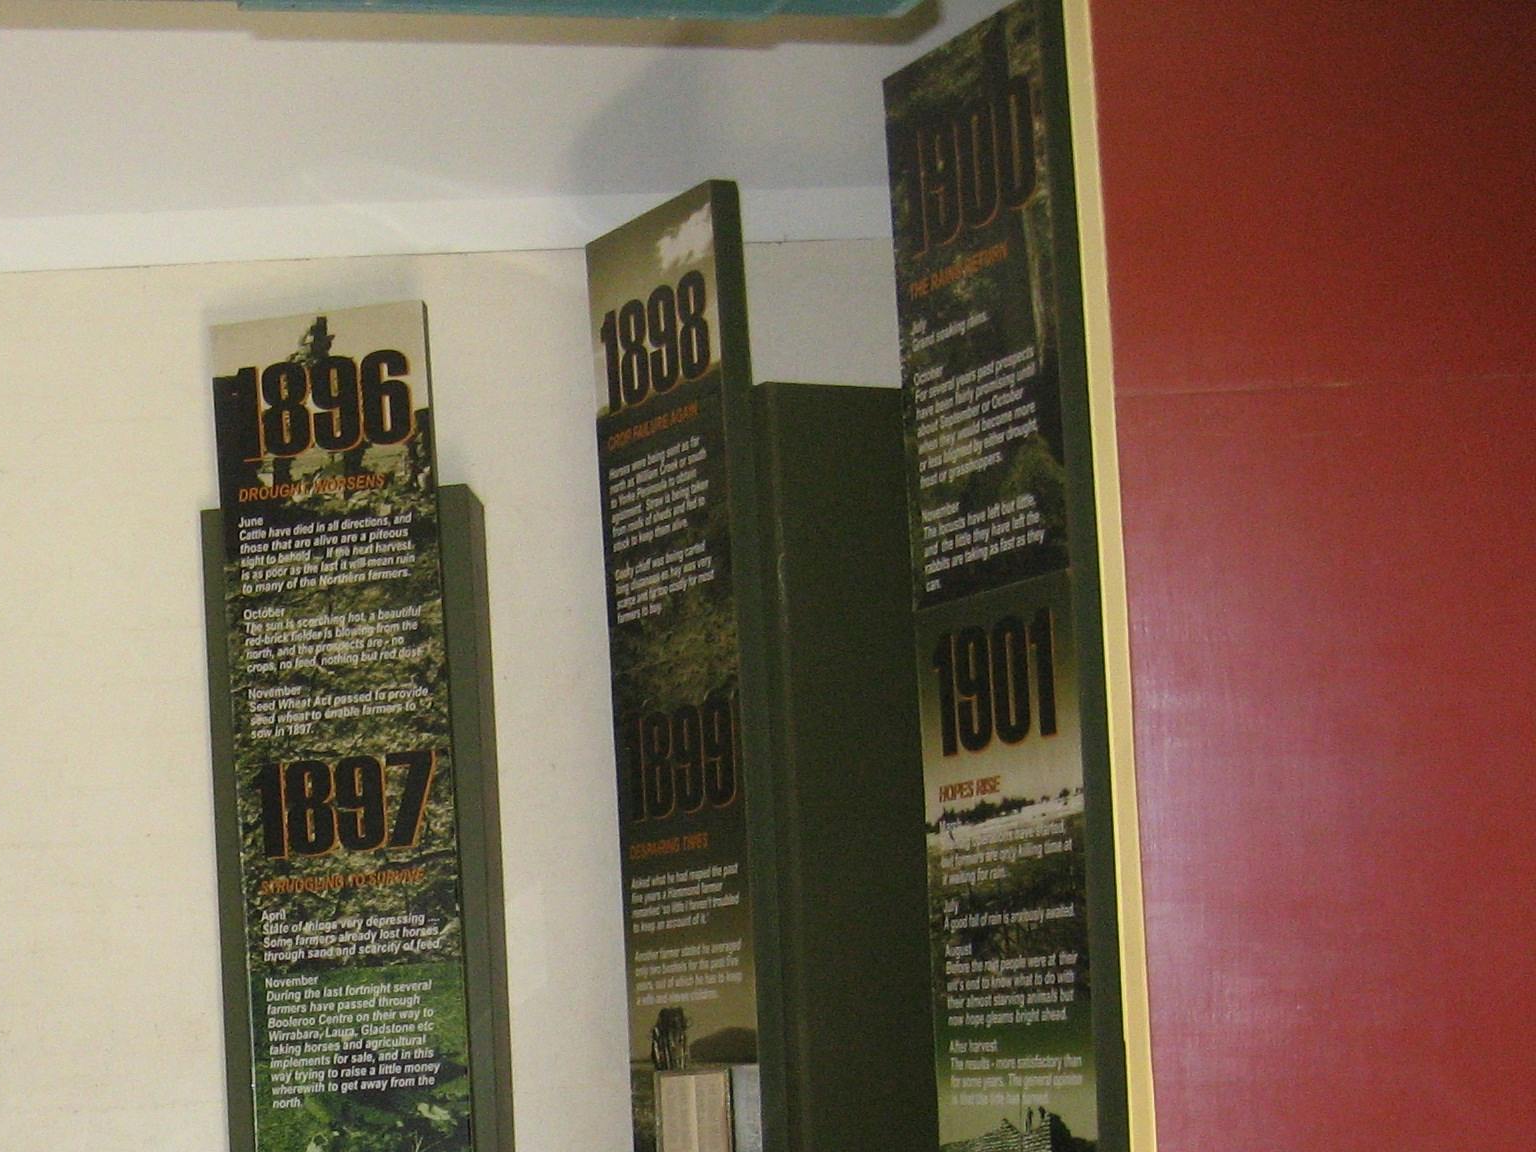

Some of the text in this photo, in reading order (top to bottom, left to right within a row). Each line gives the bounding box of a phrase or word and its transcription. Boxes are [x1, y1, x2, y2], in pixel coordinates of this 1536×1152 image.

[600, 270, 711, 416] 1898
[233, 349, 415, 462] 1896
[239, 517, 263, 528] June
[269, 528, 291, 538] have
[293, 524, 314, 535] died
[316, 522, 325, 533] in
[327, 520, 338, 531] all
[394, 513, 412, 524] and
[932, 608, 1058, 756] 1901
[624, 683, 740, 824] 1899
[259, 751, 440, 860] 1897
[939, 776, 1000, 802] HOPES RISE
[265, 975, 318, 988] November
[267, 980, 432, 1002] During the last fortnight several
